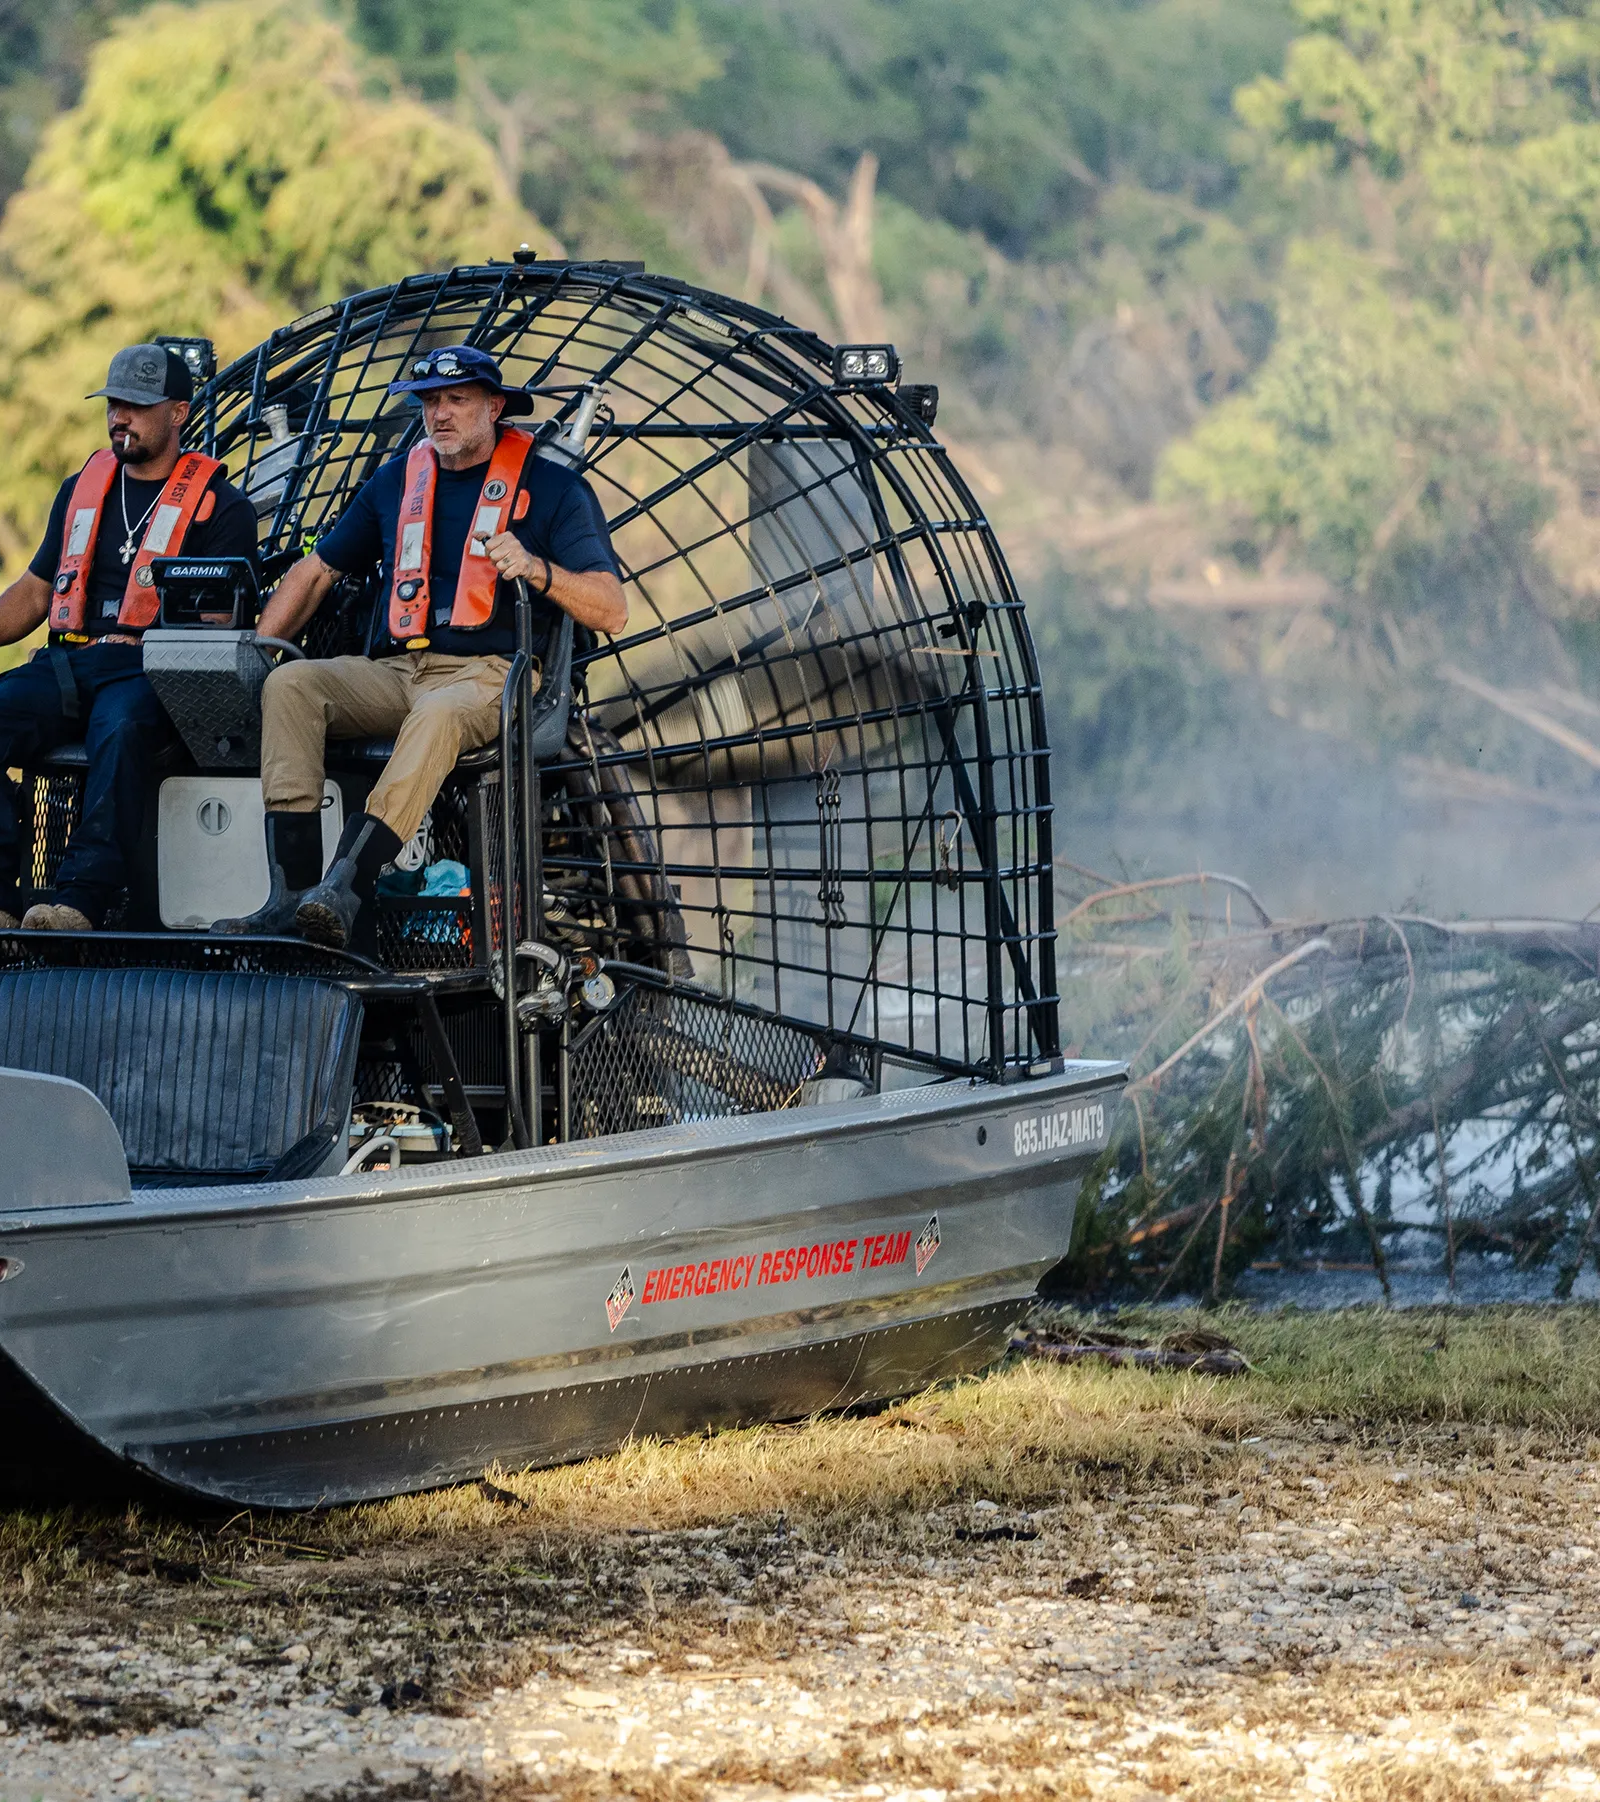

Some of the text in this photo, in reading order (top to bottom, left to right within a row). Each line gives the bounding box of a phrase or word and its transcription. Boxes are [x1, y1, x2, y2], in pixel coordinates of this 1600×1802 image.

[169, 458, 202, 503] WORK VEST
[410, 494, 424, 516] VEST
[171, 566, 224, 576] GARMIN
[1014, 1103, 1104, 1157] 855.HAZ-MAT9
[641, 1254, 758, 1304] EMERGENCY
[757, 1239, 859, 1286] RESPONSE
[860, 1230, 913, 1270] TEAM
